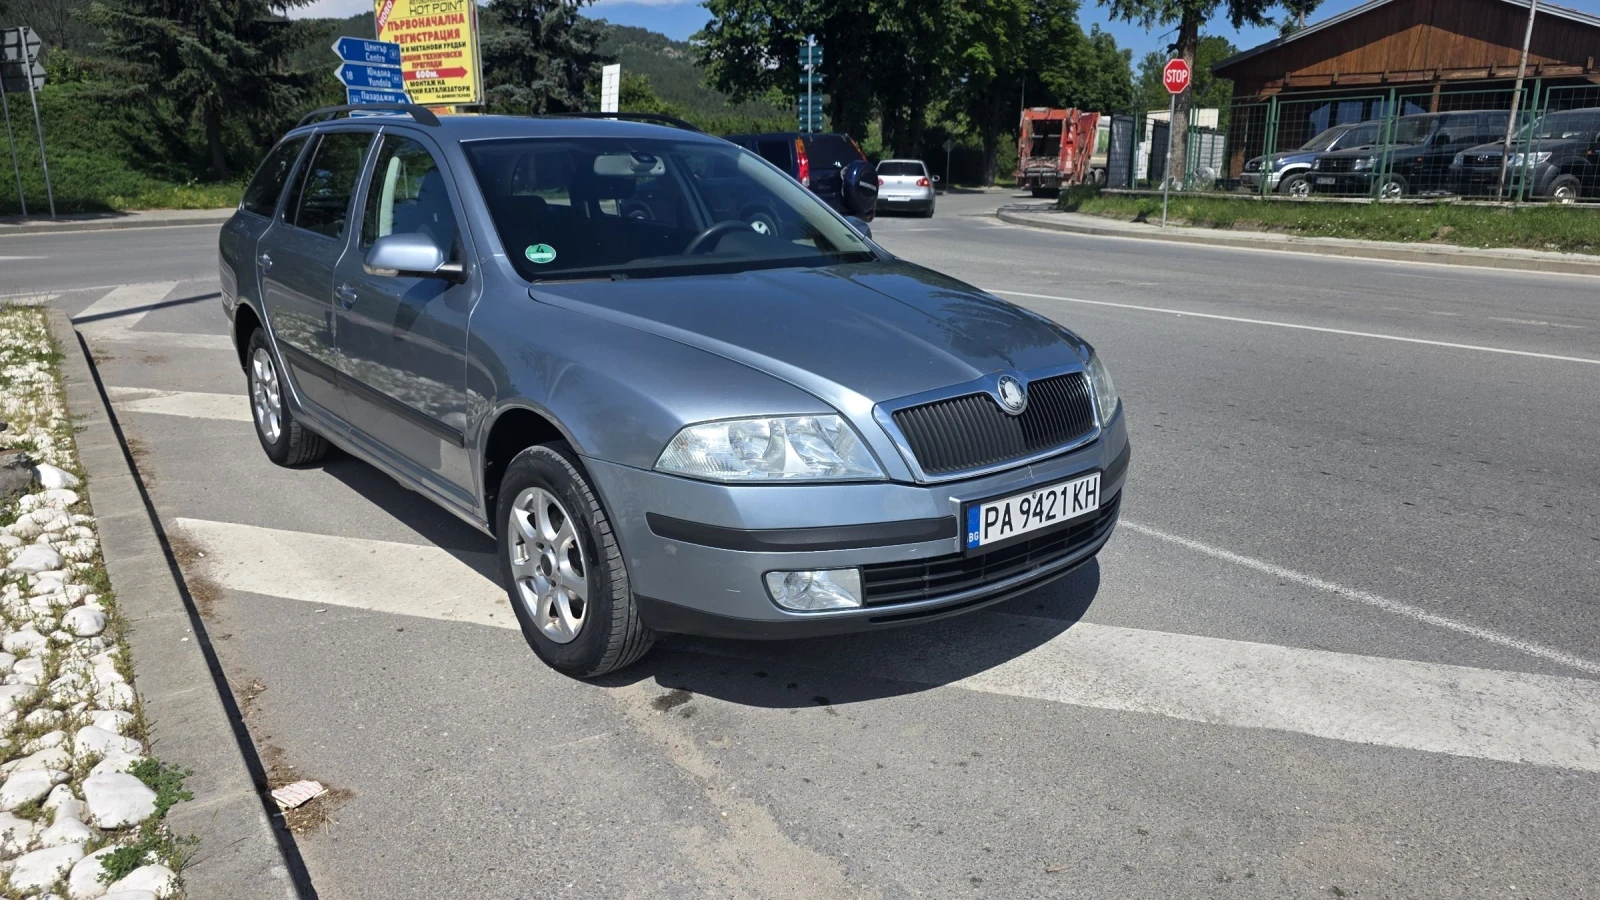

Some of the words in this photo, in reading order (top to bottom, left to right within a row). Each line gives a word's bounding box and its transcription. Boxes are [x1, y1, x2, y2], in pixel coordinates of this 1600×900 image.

[379, 0, 393, 27] НОВО
[409, 4, 430, 15] HOT
[432, 0, 464, 12] POINT
[388, 13, 465, 31] ПЪРВОНАЧАЛНА
[393, 28, 460, 44] РЕГИСТРАЦИЯ
[343, 45, 347, 54] 1
[363, 41, 387, 54] Център
[410, 43, 442, 52] МЕТАНОВИ
[443, 42, 466, 50] УРЕДБИ
[365, 52, 386, 63] Centre
[422, 50, 463, 60] ТЕХНИЧЕСКИ
[366, 67, 391, 78] Юндола
[1166, 69, 1188, 83] STOP
[367, 77, 392, 88] Yundola
[424, 86, 470, 94] КАТАЛИЗАТОРИ
[360, 90, 396, 103] Пазарджик
[536, 245, 545, 253] 4
[984, 502, 1014, 540] PA
[1019, 486, 1069, 529] 9421
[1072, 477, 1098, 513] KH
[968, 531, 979, 543] BG
